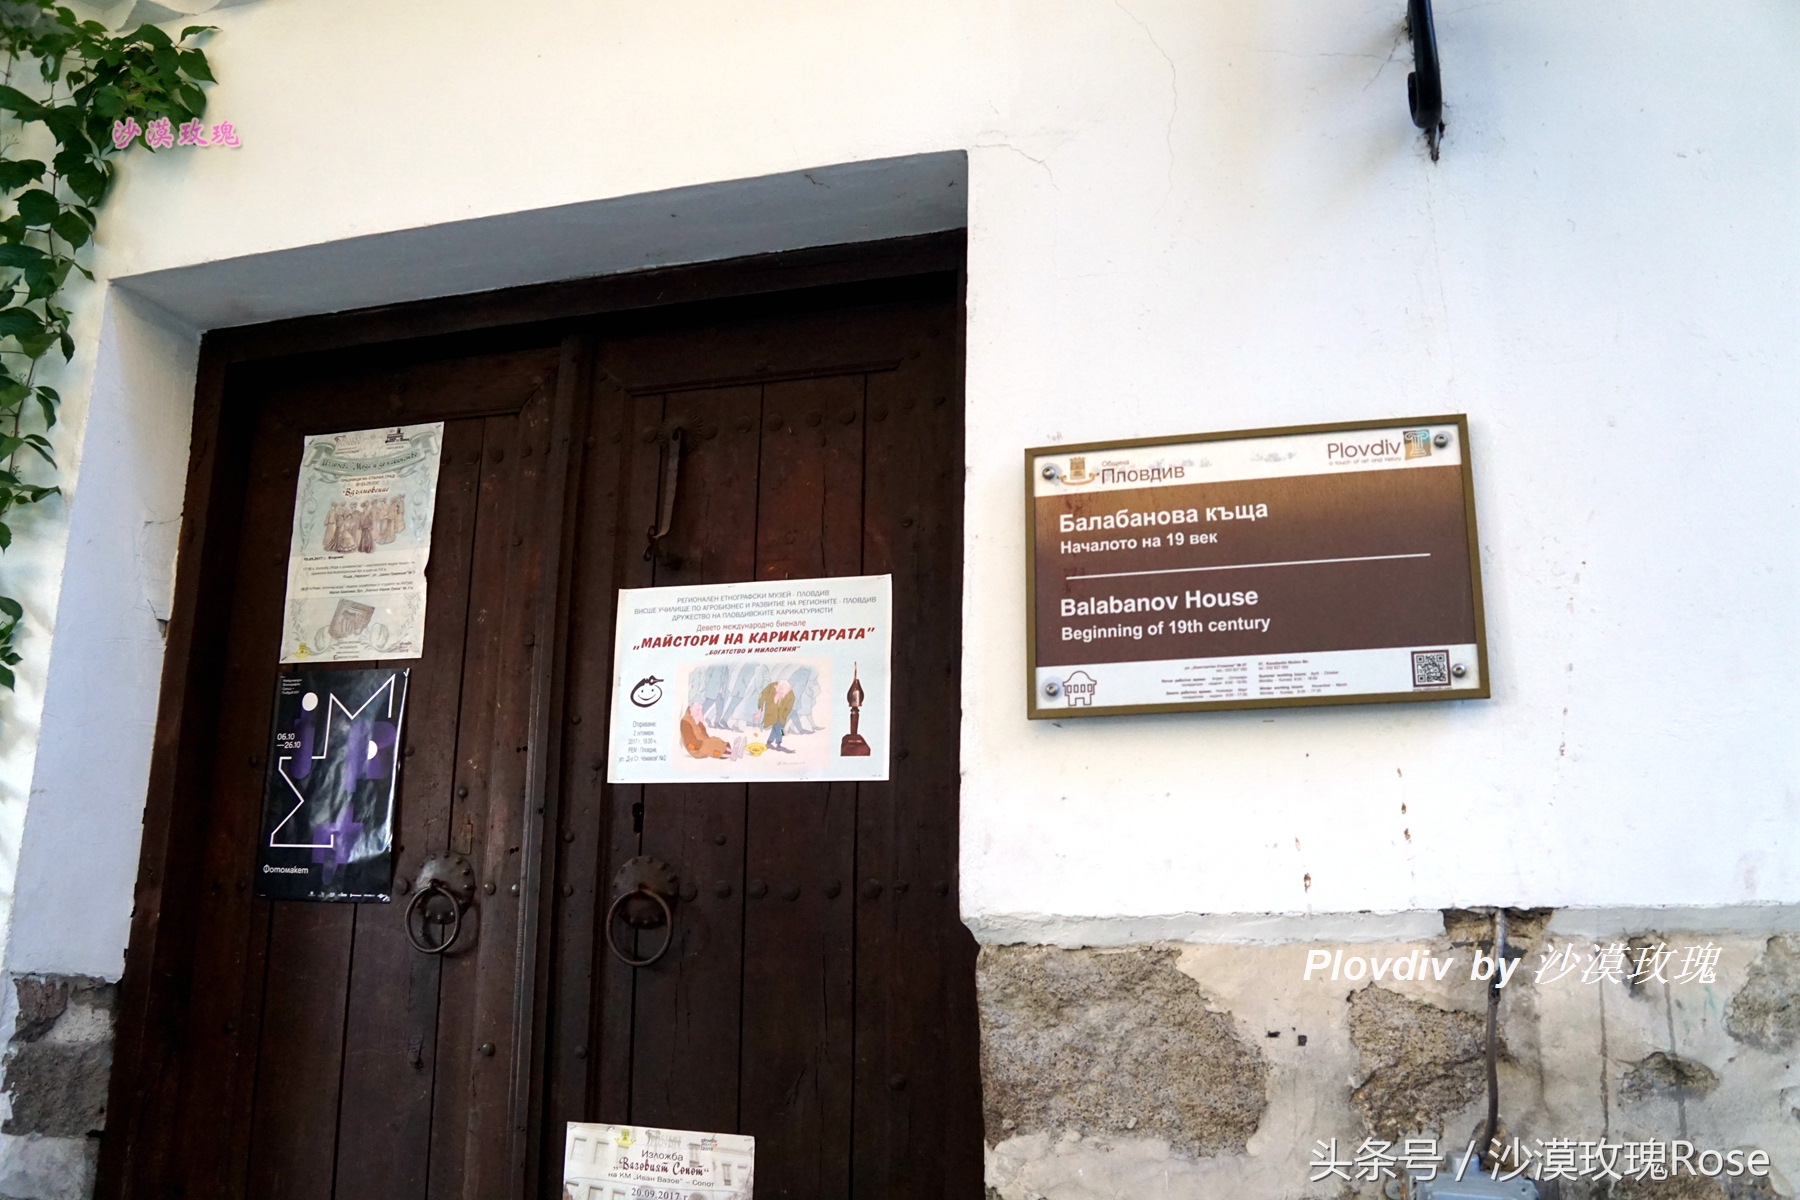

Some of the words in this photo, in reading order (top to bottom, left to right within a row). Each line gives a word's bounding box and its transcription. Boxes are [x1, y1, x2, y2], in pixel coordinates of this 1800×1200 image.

[1327, 439, 1401, 459] Plovdiv
[1102, 466, 1185, 484] Пловдив
[1060, 507, 1198, 532] Балабанова
[1205, 503, 1268, 522] къща
[1060, 538, 1137, 554] Началото
[1142, 537, 1161, 548] на
[1166, 532, 1185, 546] 19
[1190, 532, 1218, 545] век
[677, 596, 719, 604] РЕГИОНАЛЕН
[720, 592, 767, 602] ЕТНОГРАФСКИ
[768, 591, 792, 599] МУЗЕЙ
[797, 590, 830, 598] ПЛОВДИВ
[1061, 595, 1178, 617] Balabanov
[1185, 590, 1259, 609] House
[658, 605, 690, 613] УЧИЛИЩЕ
[692, 604, 701, 612] ПО
[702, 603, 743, 611] АГРОБИЗНЕС
[752, 600, 785, 608] РАЗВИТИЕ
[798, 598, 838, 606] РЕГИОНИТЕ
[843, 596, 877, 604] ПЛОВДИВ
[672, 613, 710, 621] ДРУЖЕСТВО
[722, 609, 774, 619] ПЛОВДИВСКИТЕ
[776, 607, 833, 616] КАРИКАТУРИСТИ
[696, 624, 720, 632] Девето
[722, 621, 774, 632] международно
[776, 619, 806, 627] биенале
[1062, 623, 1142, 643] Beginning
[1147, 621, 1164, 636] of
[1169, 619, 1203, 635] 19th
[1208, 617, 1271, 632] century
[724, 633, 743, 645] НА
[277, 733, 296, 741] 06.10
[263, 864, 309, 874] Фотомакет
[641, 1149, 683, 1161] Изложба
[692, 1179, 715, 1187] Сопот
[631, 1187, 680, 1200] 20.09.2017
